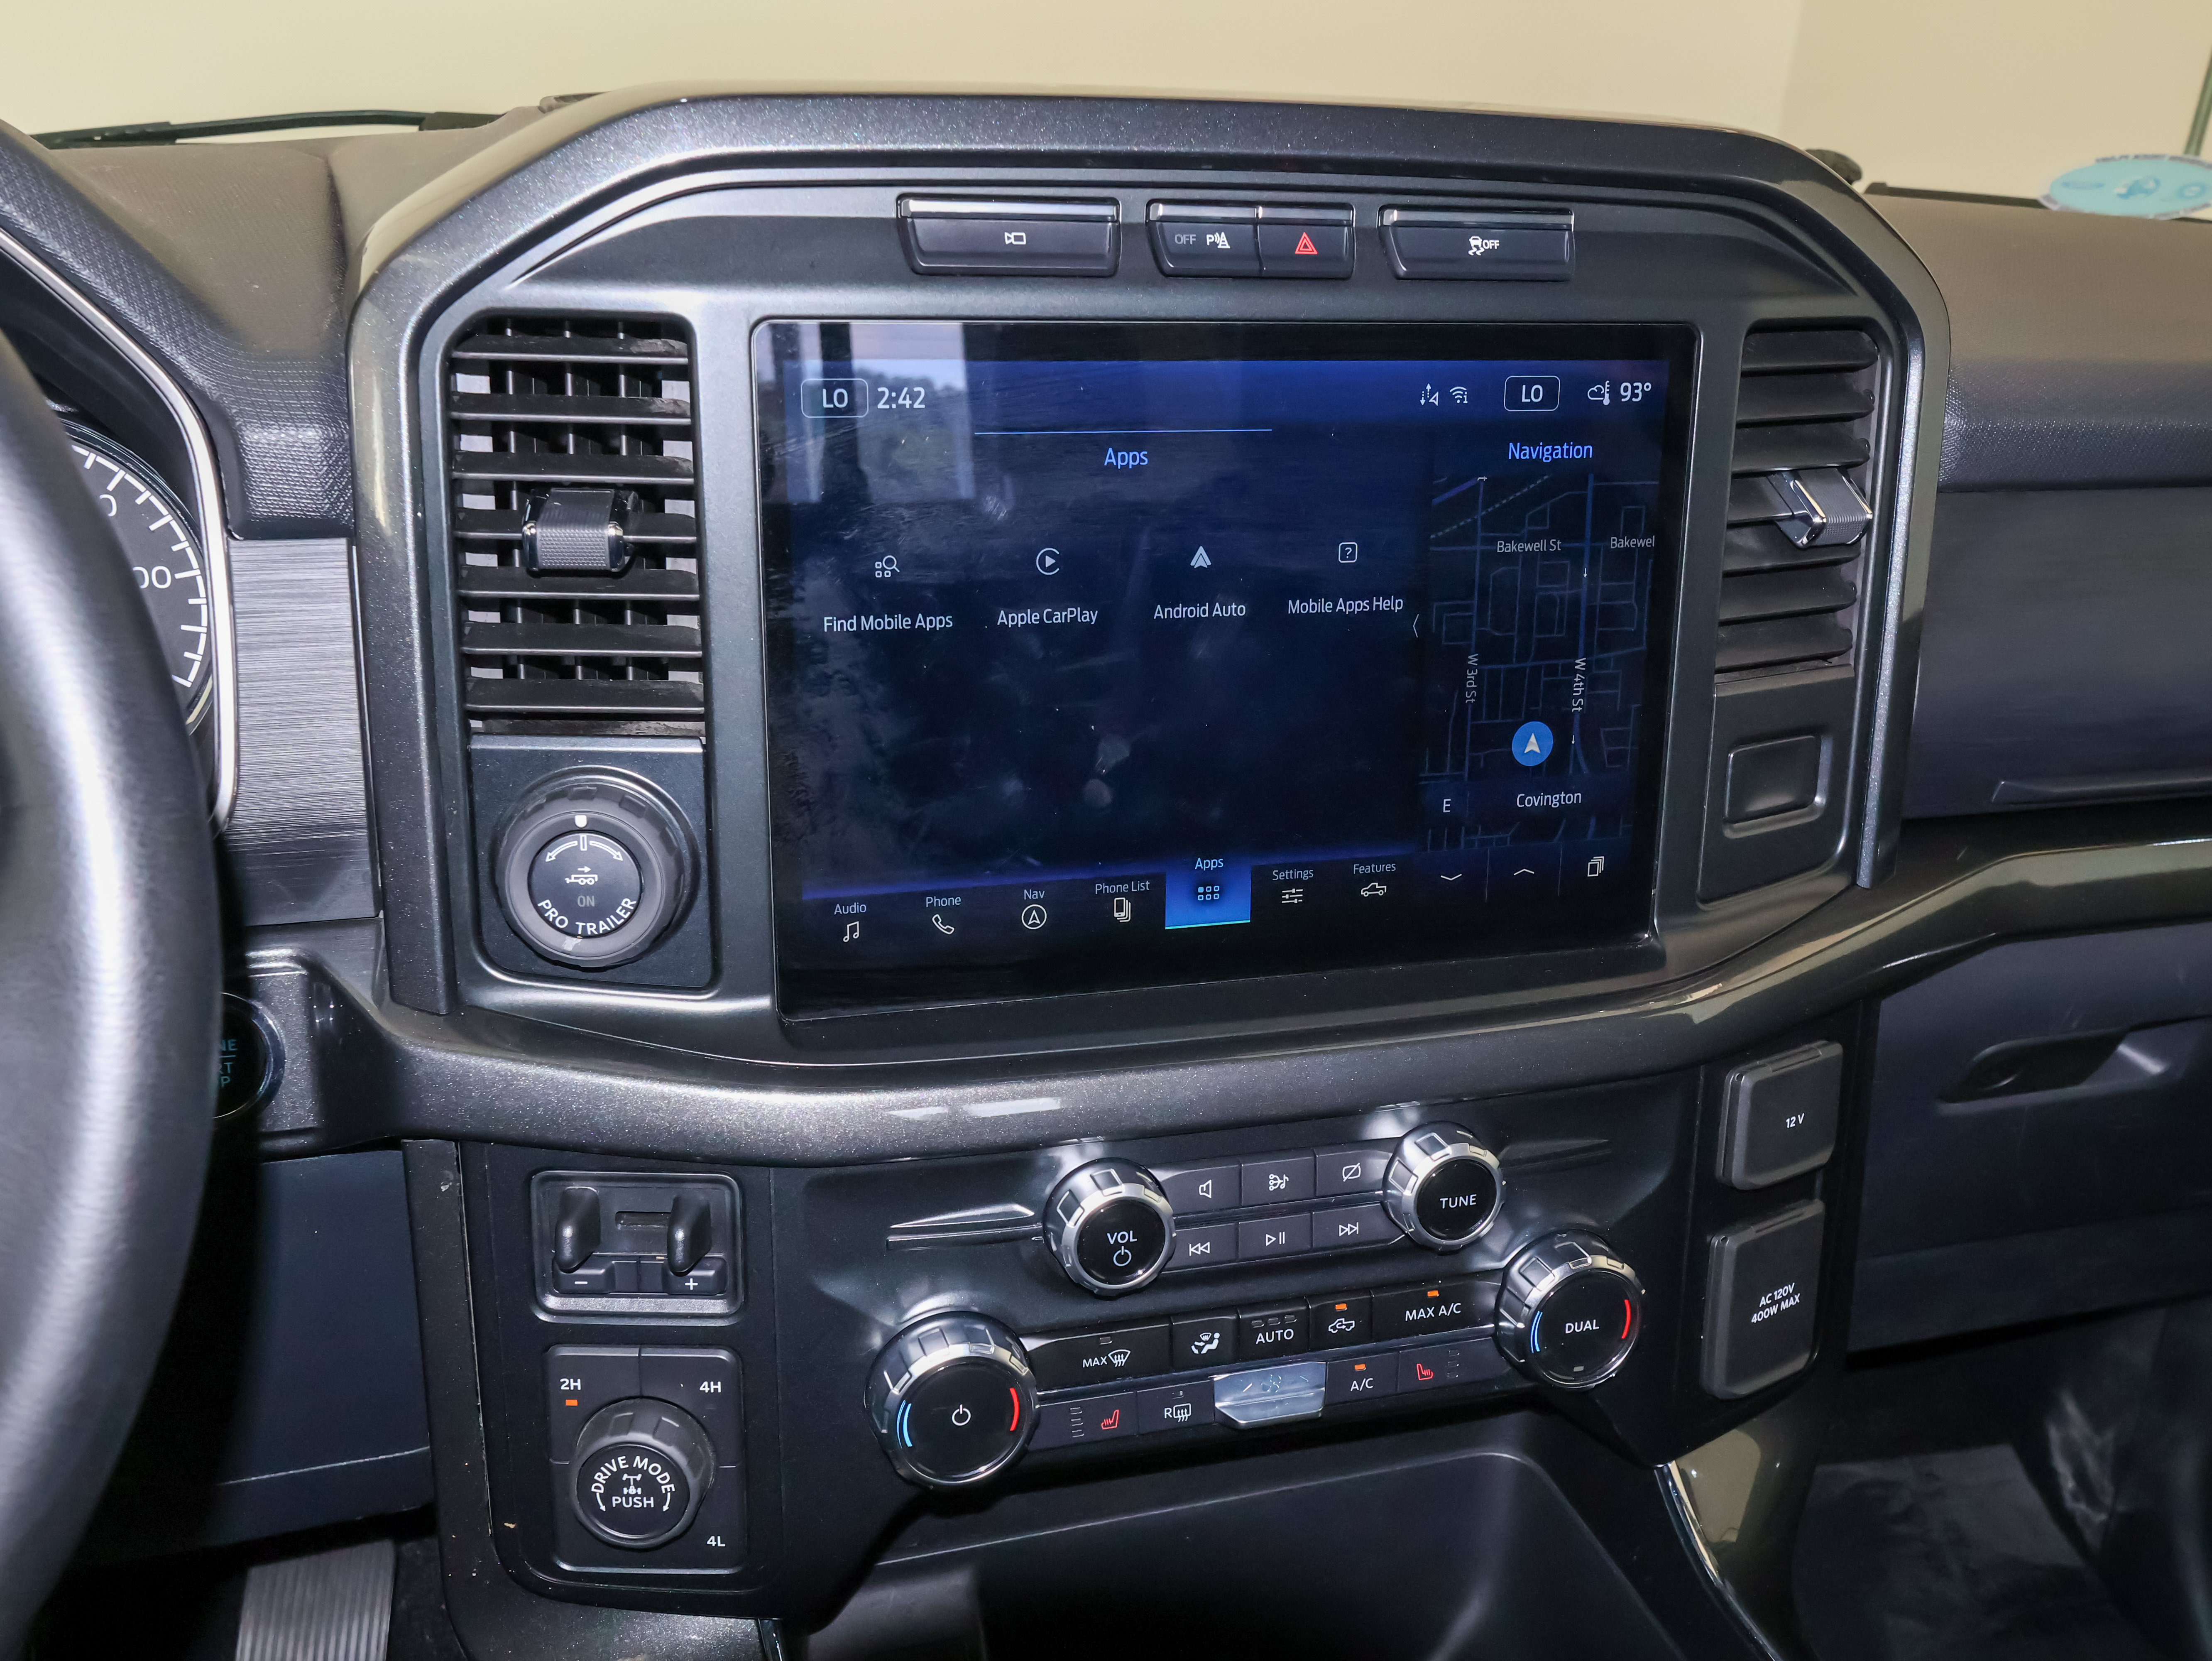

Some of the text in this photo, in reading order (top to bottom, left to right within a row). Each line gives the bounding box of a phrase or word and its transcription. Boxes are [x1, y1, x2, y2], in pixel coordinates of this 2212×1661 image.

[1174, 234, 1197, 245] OFF
[1482, 239, 1500, 250] OFF
[822, 389, 849, 409] LO
[877, 387, 926, 409] 2:42
[1522, 385, 1543, 402] LO
[1104, 447, 1148, 469] Apps
[1508, 442, 1593, 463] Navigation
[98, 494, 117, 517] 0
[1497, 539, 1561, 553] Bakewell St
[132, 565, 172, 589] 00
[1154, 602, 1246, 619] Android Auto
[1288, 595, 1403, 615] Mobile Apps Help
[824, 612, 953, 632] Find Mobile Apps
[997, 607, 1098, 627] Apple CarPlay
[1466, 654, 1478, 703] W 3rd St
[1571, 658, 1586, 712] W 4th St
[1443, 799, 1451, 813] E
[1516, 791, 1582, 808] Covington
[1195, 857, 1224, 870] Apps
[1353, 862, 1397, 875] Features
[1272, 867, 1314, 882] Settings
[1023, 889, 1045, 900] Nav
[1095, 880, 1150, 894] Phone List
[577, 895, 595, 907] ON
[834, 902, 867, 916] Audio
[925, 895, 962, 908] Phone
[537, 897, 636, 935] PRO TRAILER
[1786, 1113, 1805, 1129] 12 V
[1440, 1193, 1477, 1209] TUNE
[1107, 1231, 1137, 1244] VOL
[1759, 1282, 1795, 1307] AC 120V
[1405, 1303, 1461, 1321] MAX A/C
[1751, 1293, 1800, 1324] 400W MAX
[1565, 1318, 1600, 1334] DUAL
[1255, 1328, 1294, 1345] AUTO
[1082, 1355, 1108, 1369] MAX
[560, 1378, 581, 1391] 2H
[699, 1381, 721, 1393] 4H
[1350, 1378, 1374, 1392] A/C
[591, 1456, 675, 1494] DRIVE MODE
[612, 1496, 654, 1508] PUSH
[706, 1536, 726, 1547] 4L
